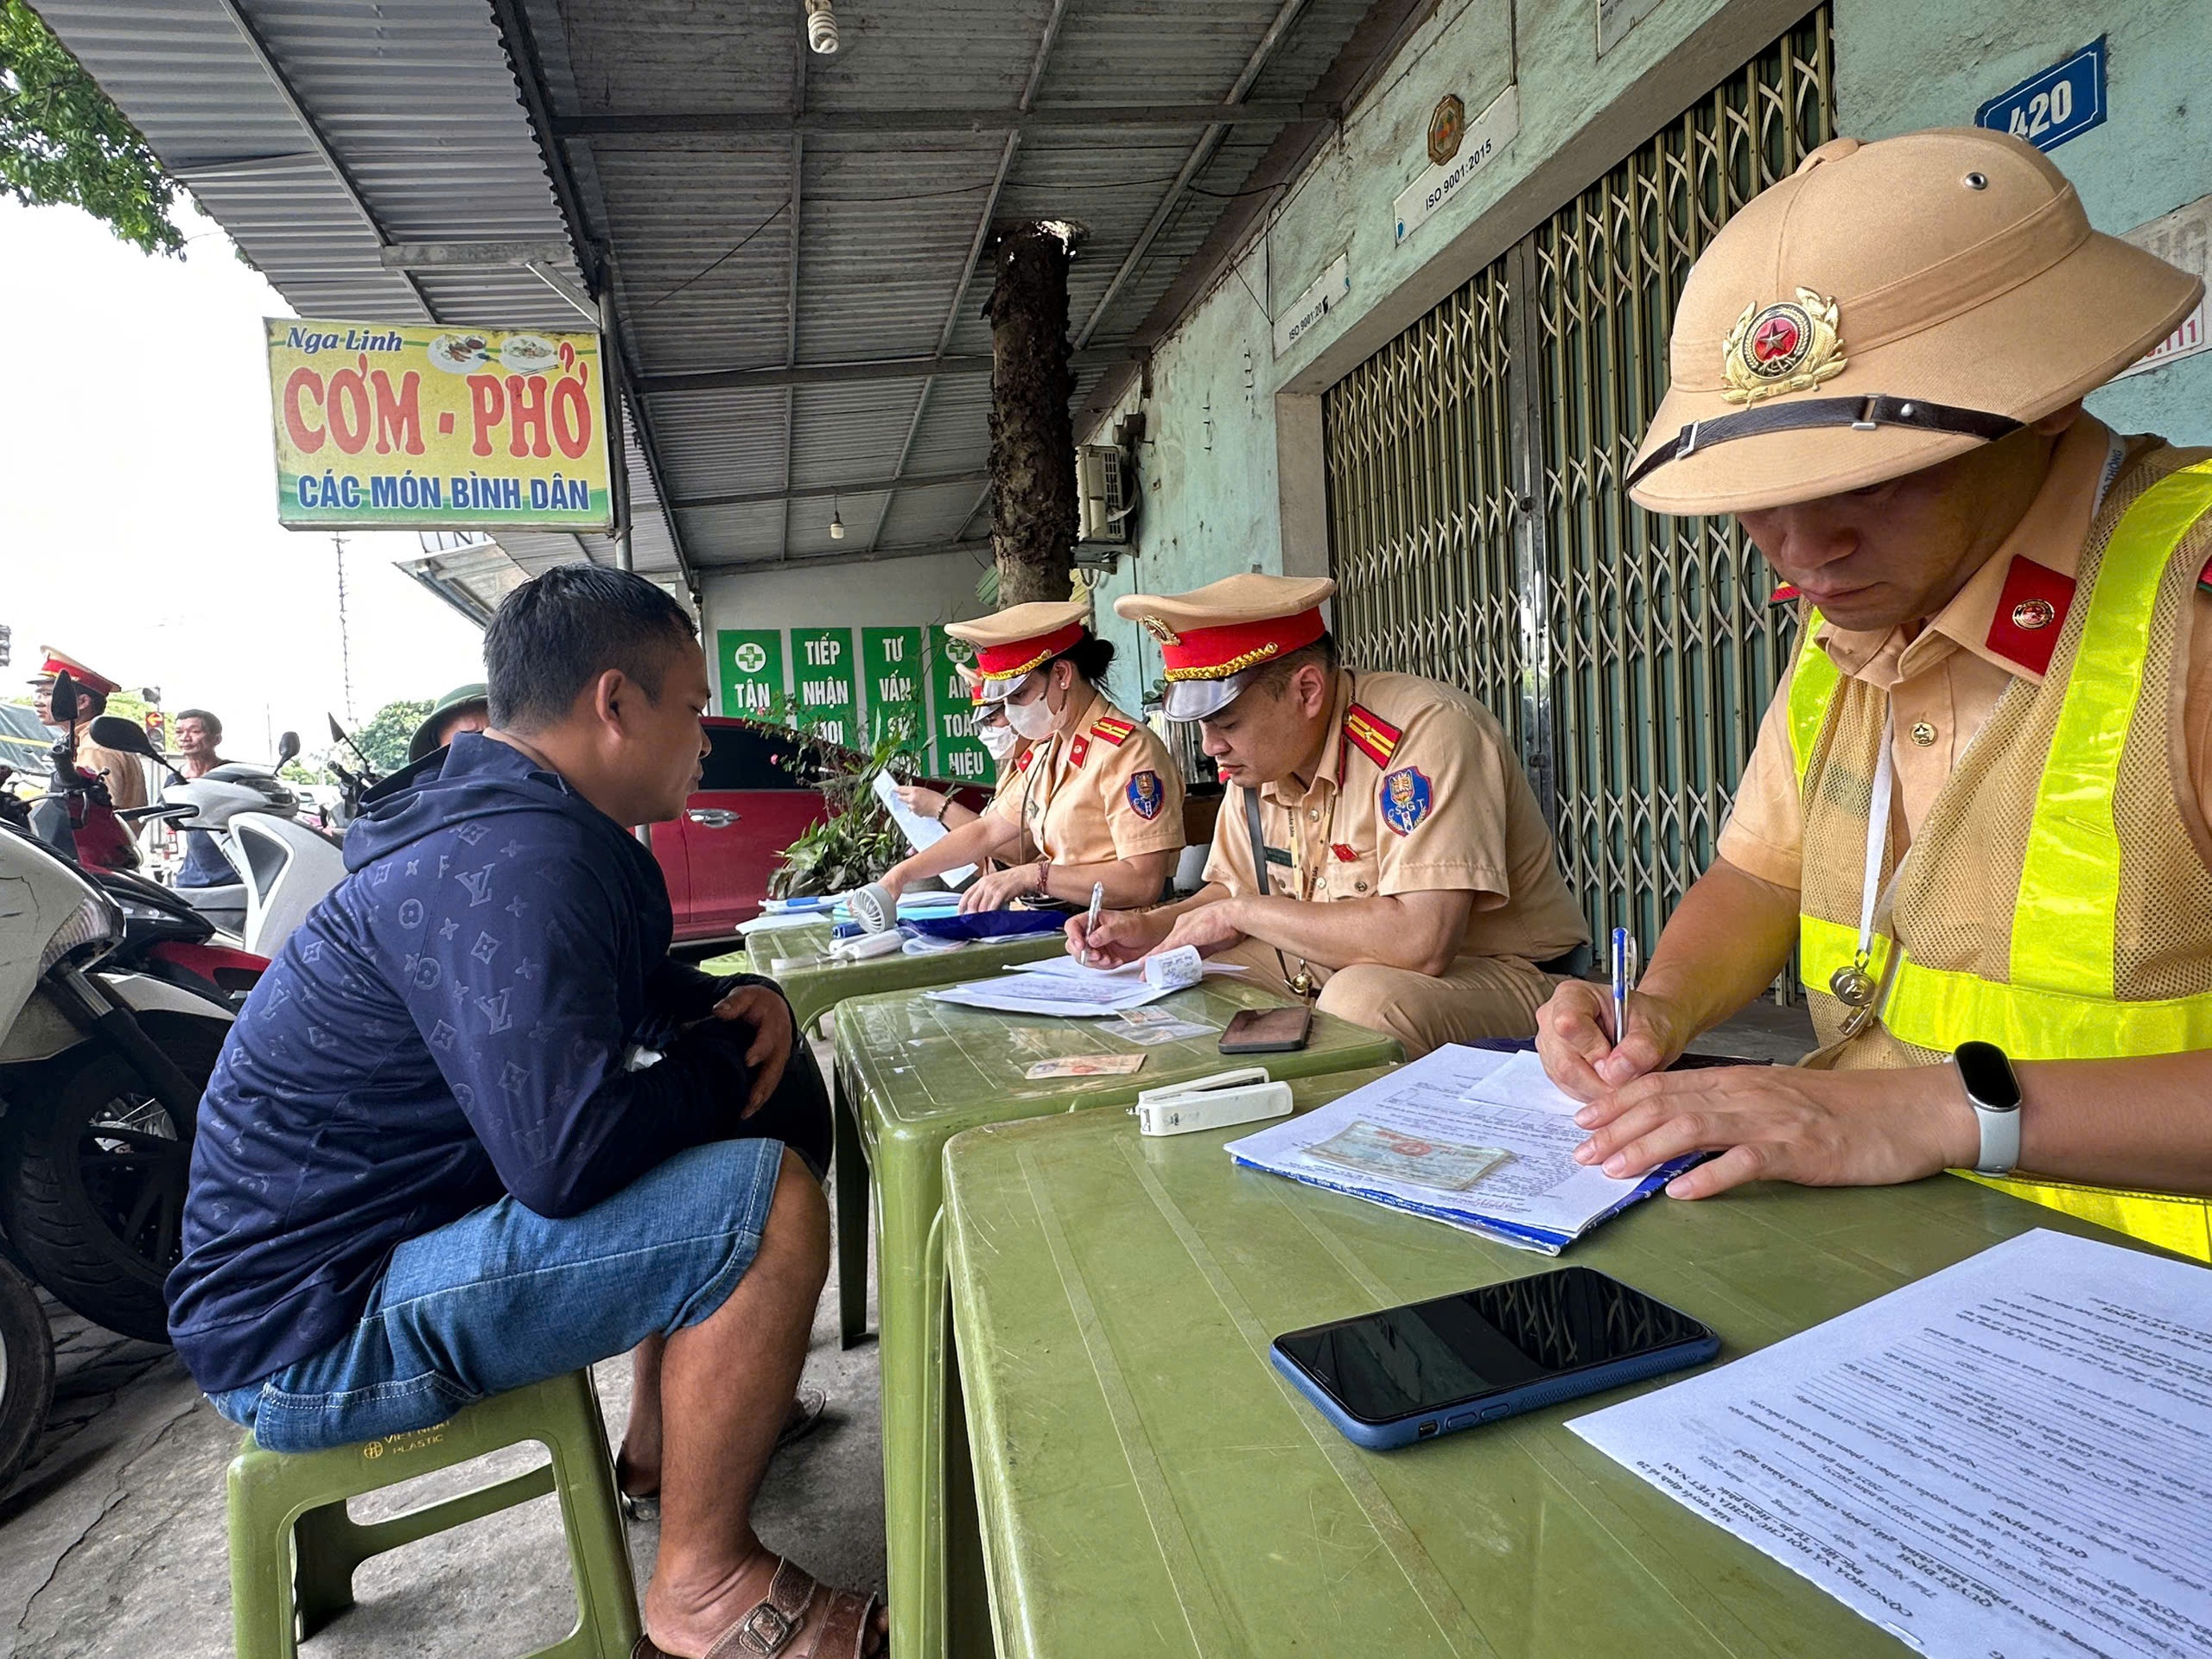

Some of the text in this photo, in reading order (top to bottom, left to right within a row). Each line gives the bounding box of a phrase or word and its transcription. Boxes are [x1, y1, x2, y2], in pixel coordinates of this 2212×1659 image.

[2008, 79, 2072, 137] 420
[1426, 139, 1492, 211] ISO 9001:2015
[285, 327, 403, 354] Nga Linh
[1289, 325, 1300, 341] ISO
[283, 353, 426, 455] CƠM
[466, 341, 592, 460] PHỞ
[298, 468, 590, 511] CÁC MÓN BÌNH DÂN
[804, 632, 841, 665] TIẾP
[882, 635, 904, 663] TƯ
[734, 679, 771, 713] TẬN
[802, 677, 849, 709] NHẬN
[879, 669, 912, 702] VẤN
[948, 747, 985, 779] HIỆU
[1388, 798, 1425, 818] CSGT
[393, 1434, 444, 1455] PLASTIC
[1662, 1462, 1689, 1480] NAM
[1688, 1480, 1721, 1498] VIỆT
[1719, 1497, 1759, 1522] NGHĨA
[1757, 1522, 1787, 1538] CHỦ
[1785, 1537, 1814, 1554] HỘI
[1812, 1553, 1834, 1567] XÃ
[1896, 1553, 1993, 1608] QUYẾT ĐỊNH
[1866, 1588, 1914, 1618] CỘNG
